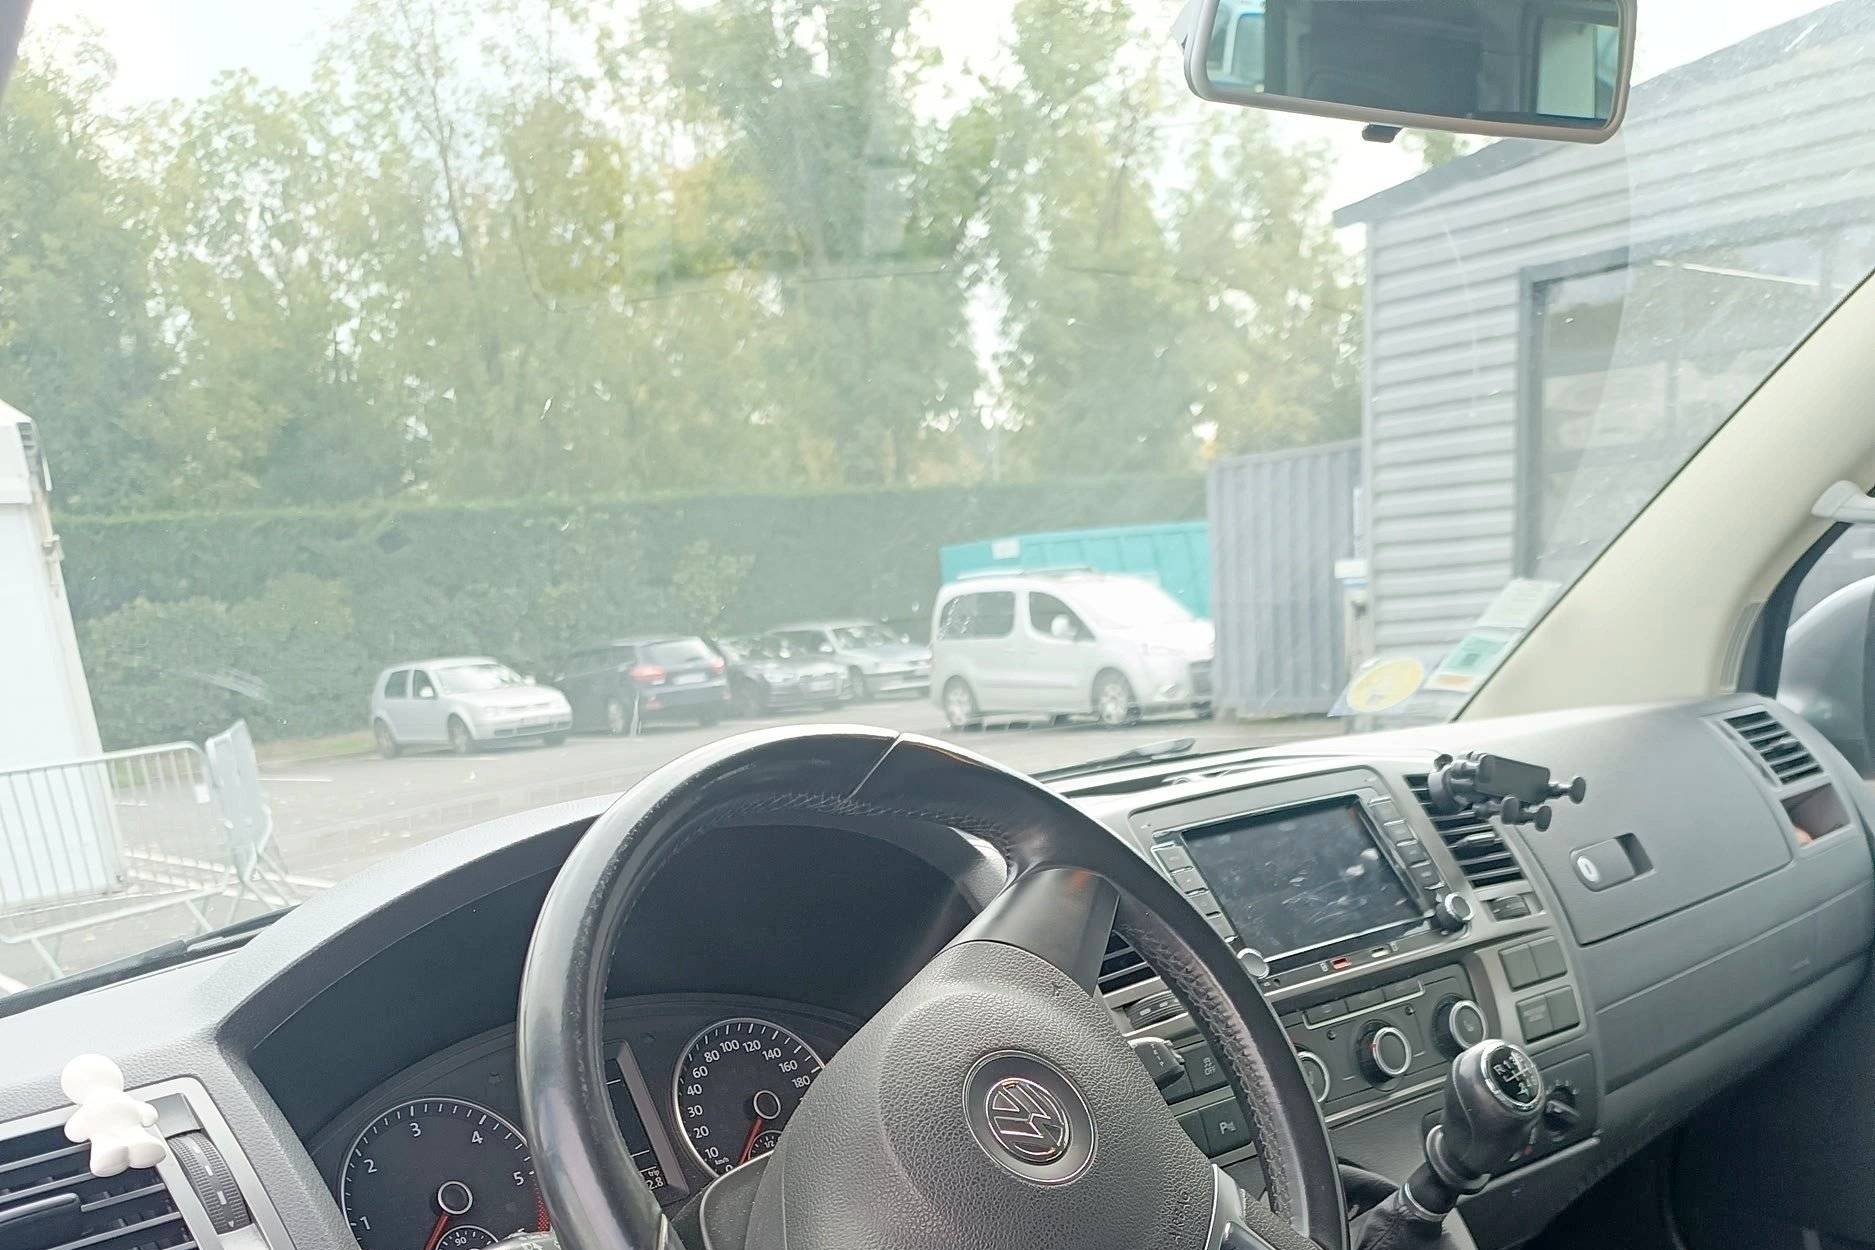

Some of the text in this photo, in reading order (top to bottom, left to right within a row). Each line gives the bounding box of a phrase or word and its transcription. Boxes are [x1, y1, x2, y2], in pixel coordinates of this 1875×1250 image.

[719, 1040, 740, 1053] 100
[742, 1040, 761, 1053] 120
[704, 1050, 720, 1063] 80
[762, 1048, 782, 1061] 140
[692, 1066, 708, 1079] 60
[778, 1059, 798, 1074] 160
[792, 1075, 811, 1088] 180
[686, 1084, 703, 1097] 40
[687, 1105, 703, 1118] 30
[410, 1122, 422, 1137] 3
[693, 1126, 709, 1139] 20
[471, 1130, 483, 1145] 4
[705, 1147, 719, 1159] 10
[364, 1158, 377, 1174] 2
[513, 1171, 524, 1186] 5
[360, 1216, 371, 1231] 1
[455, 1236, 467, 1246] 90
